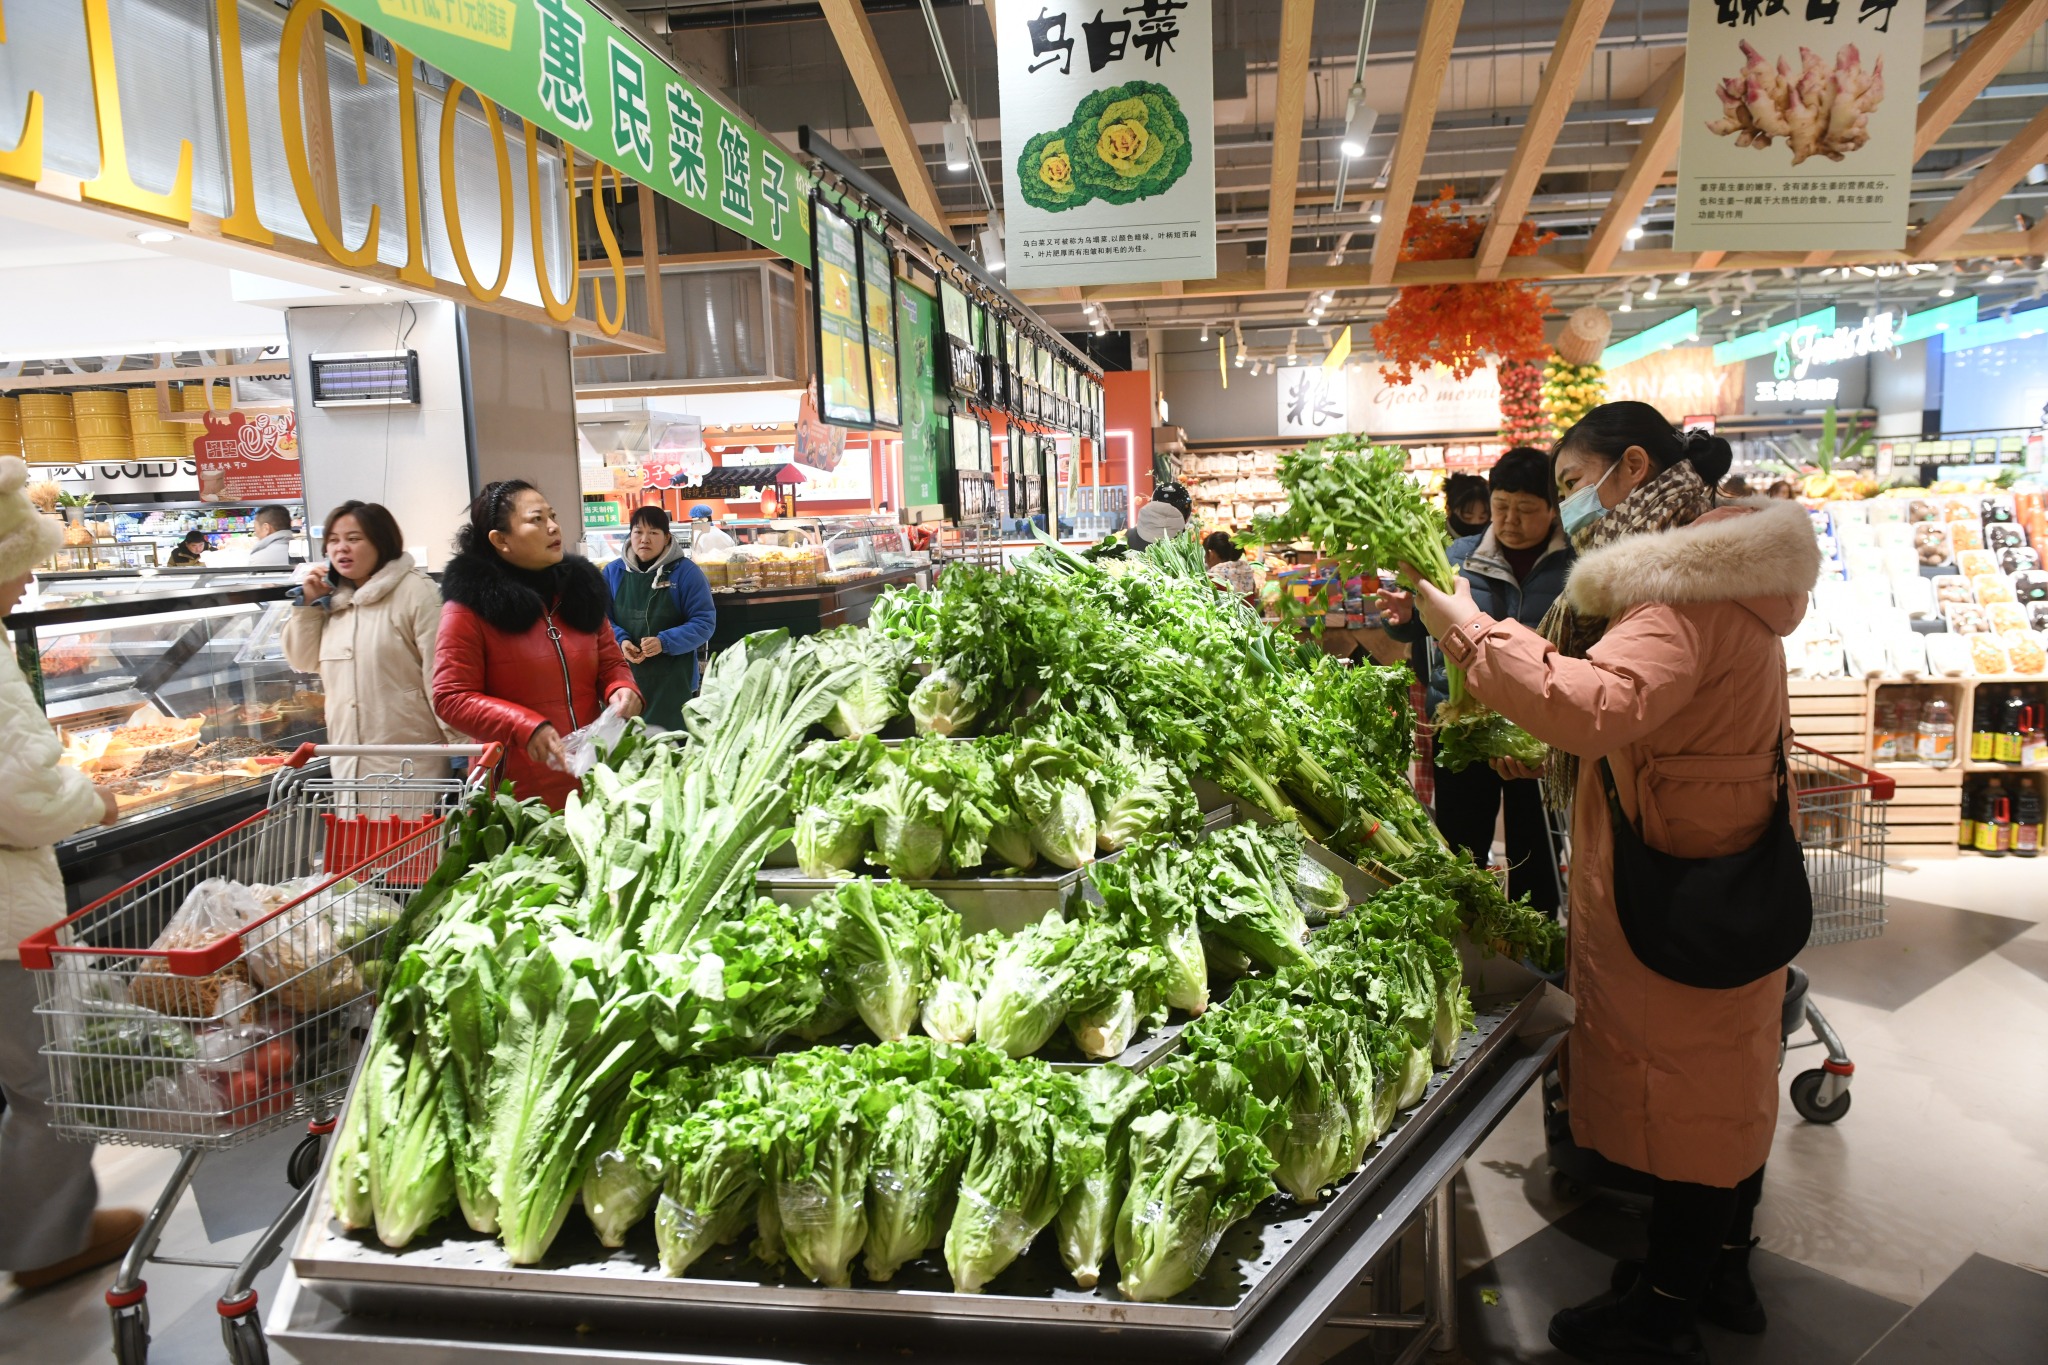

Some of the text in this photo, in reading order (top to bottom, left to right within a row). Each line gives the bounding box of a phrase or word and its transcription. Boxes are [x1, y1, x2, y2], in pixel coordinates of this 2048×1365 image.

[1027, 0, 1188, 74] 乌白菜
[537, 0, 789, 241] 惠民菜篮子
[1698, 210, 1743, 219] 功能与作用
[1286, 368, 1344, 426] 粮
[1373, 383, 1497, 410] Good morni
[1614, 373, 1728, 400] ANARY
[233, 461, 247, 469] 可口
[683, 485, 739, 500] 传统手工面食
[585, 506, 614, 514] 当天制作
